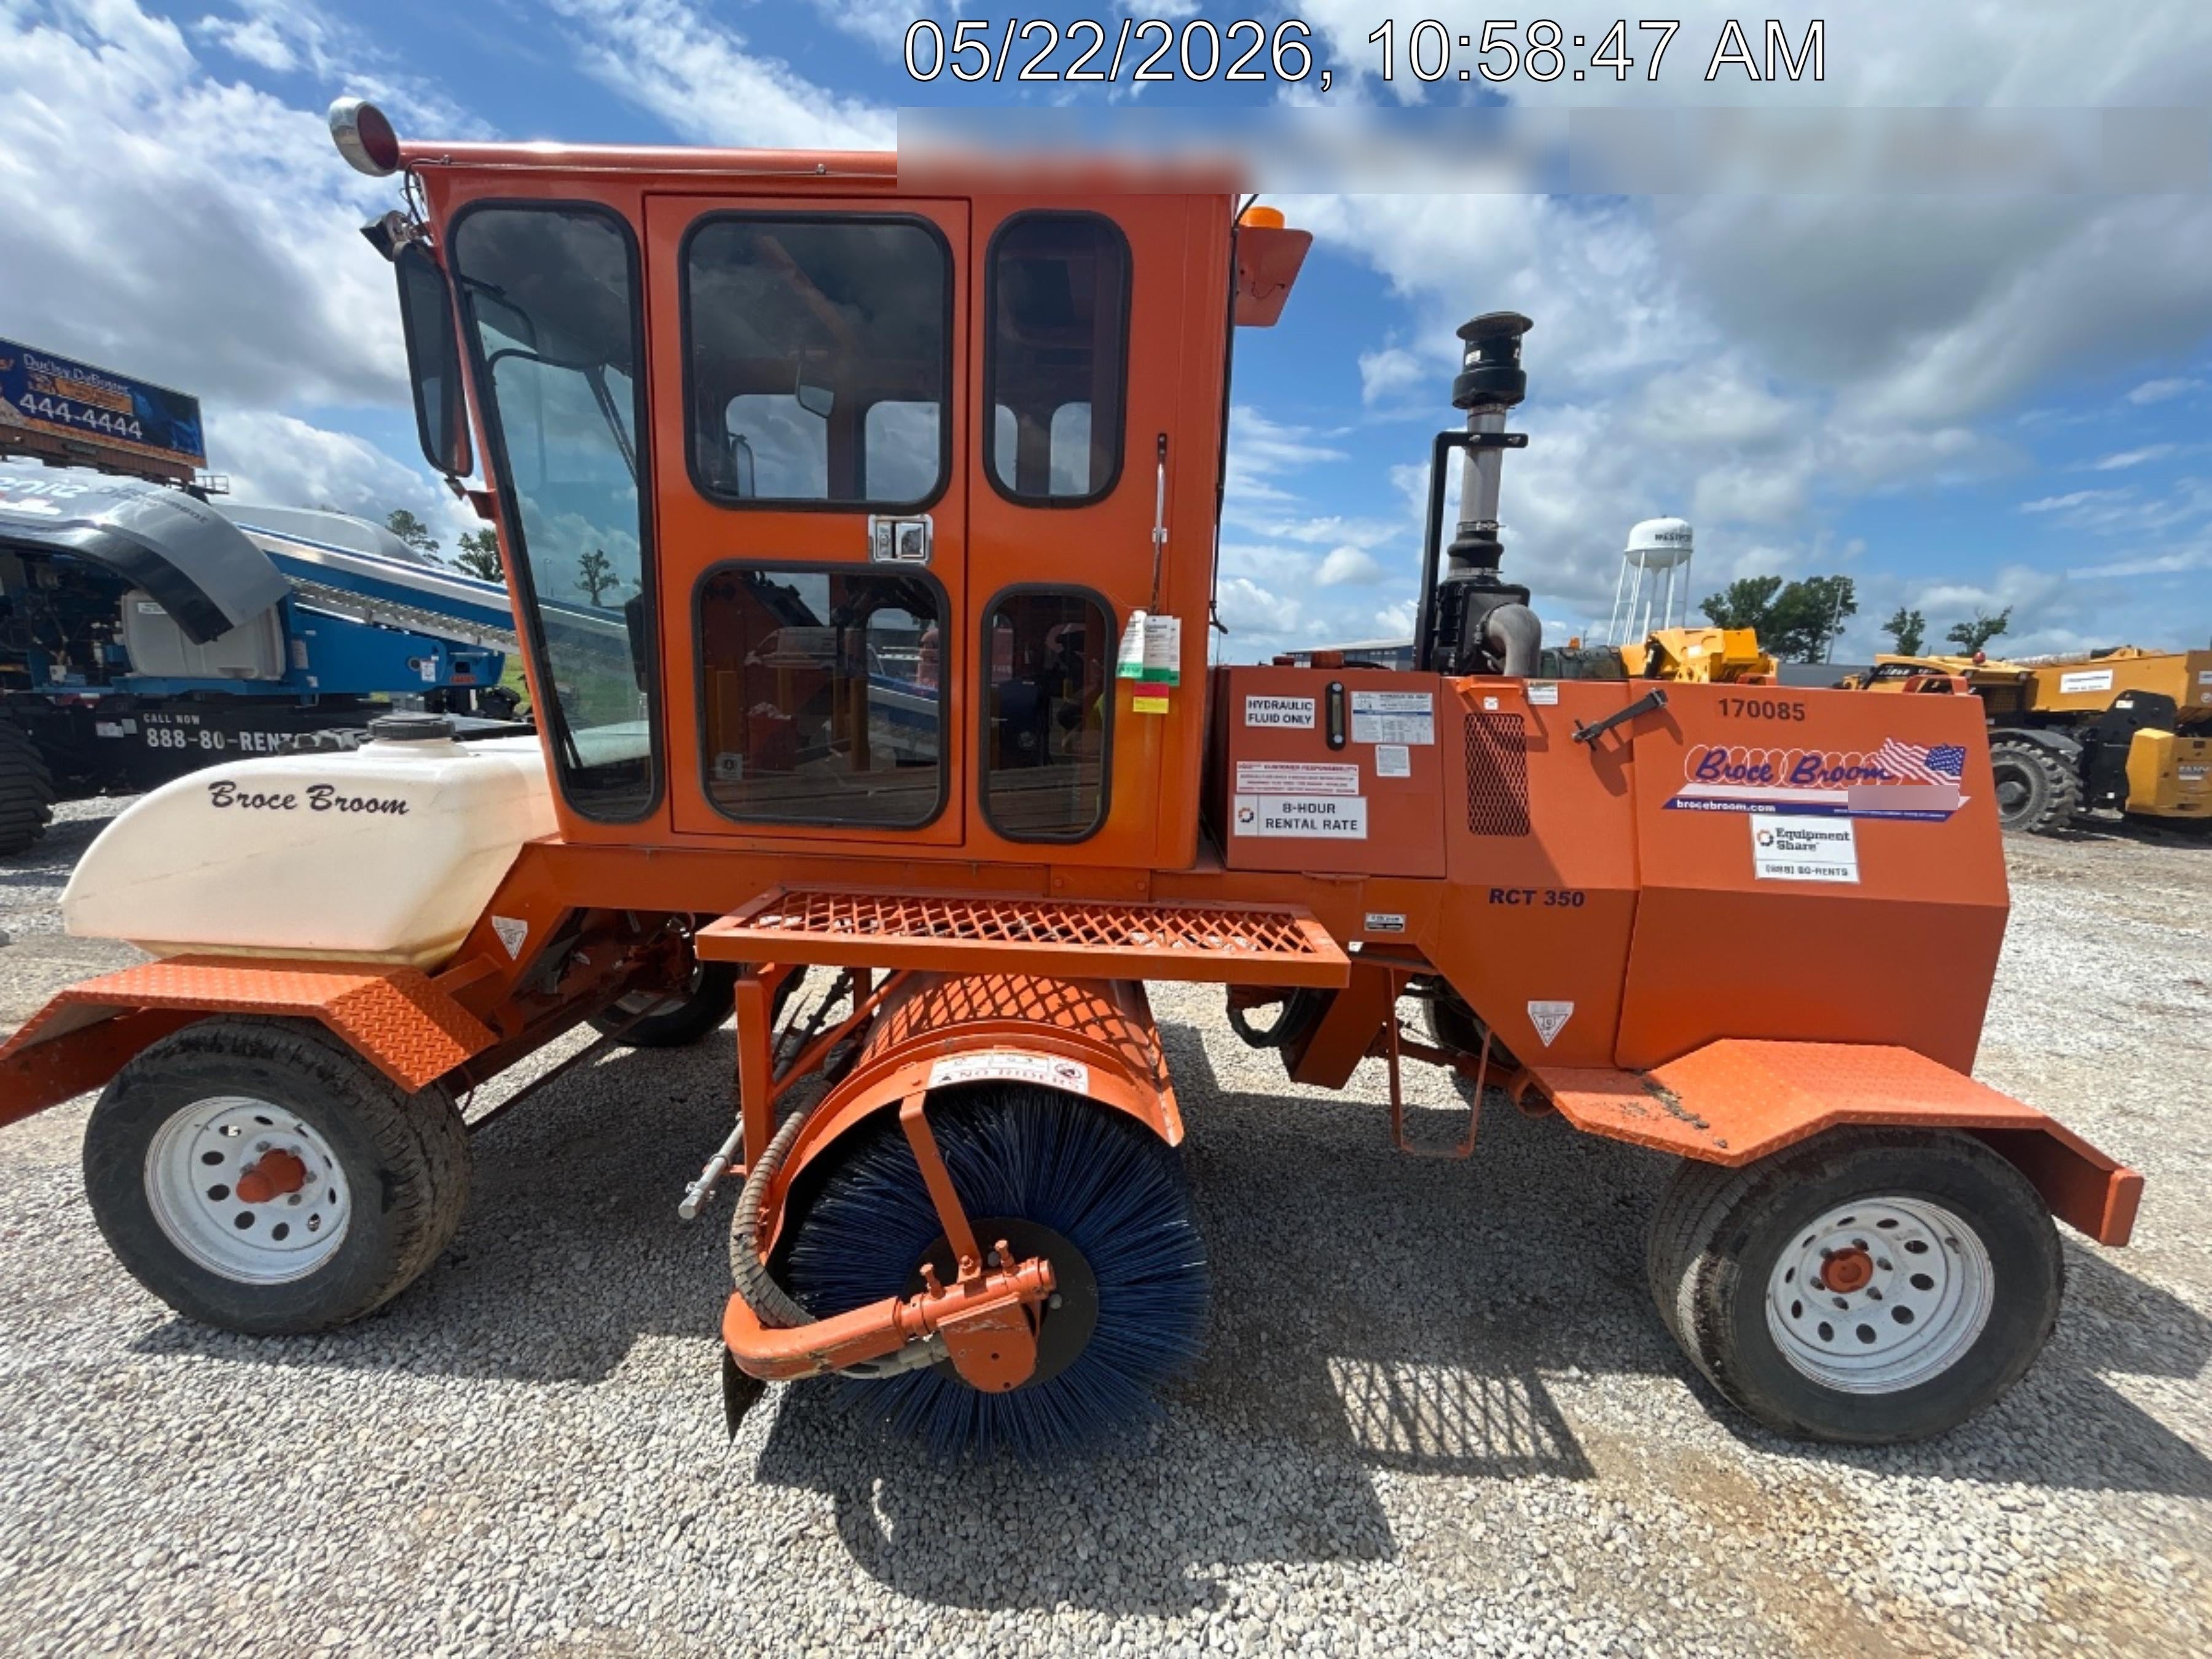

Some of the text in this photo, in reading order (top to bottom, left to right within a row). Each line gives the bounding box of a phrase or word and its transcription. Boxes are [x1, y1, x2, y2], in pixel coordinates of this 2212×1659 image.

[20, 394, 143, 439] 444-4444
[1249, 700, 1313, 712] HYDRAULIC
[1718, 699, 1805, 721] 170085
[143, 713, 200, 725] CALL NOW
[1248, 713, 1312, 724] FLUID ONLY
[1696, 749, 1895, 785] Broce Broom
[208, 780, 410, 815] Broce Broom
[1282, 803, 1336, 814] 8-HOUR
[1676, 799, 1776, 812] brocebroom.com
[1266, 818, 1358, 831] RENTAL RATE
[1775, 828, 1851, 841] Equipment
[1489, 888, 1585, 908] RCT 350
